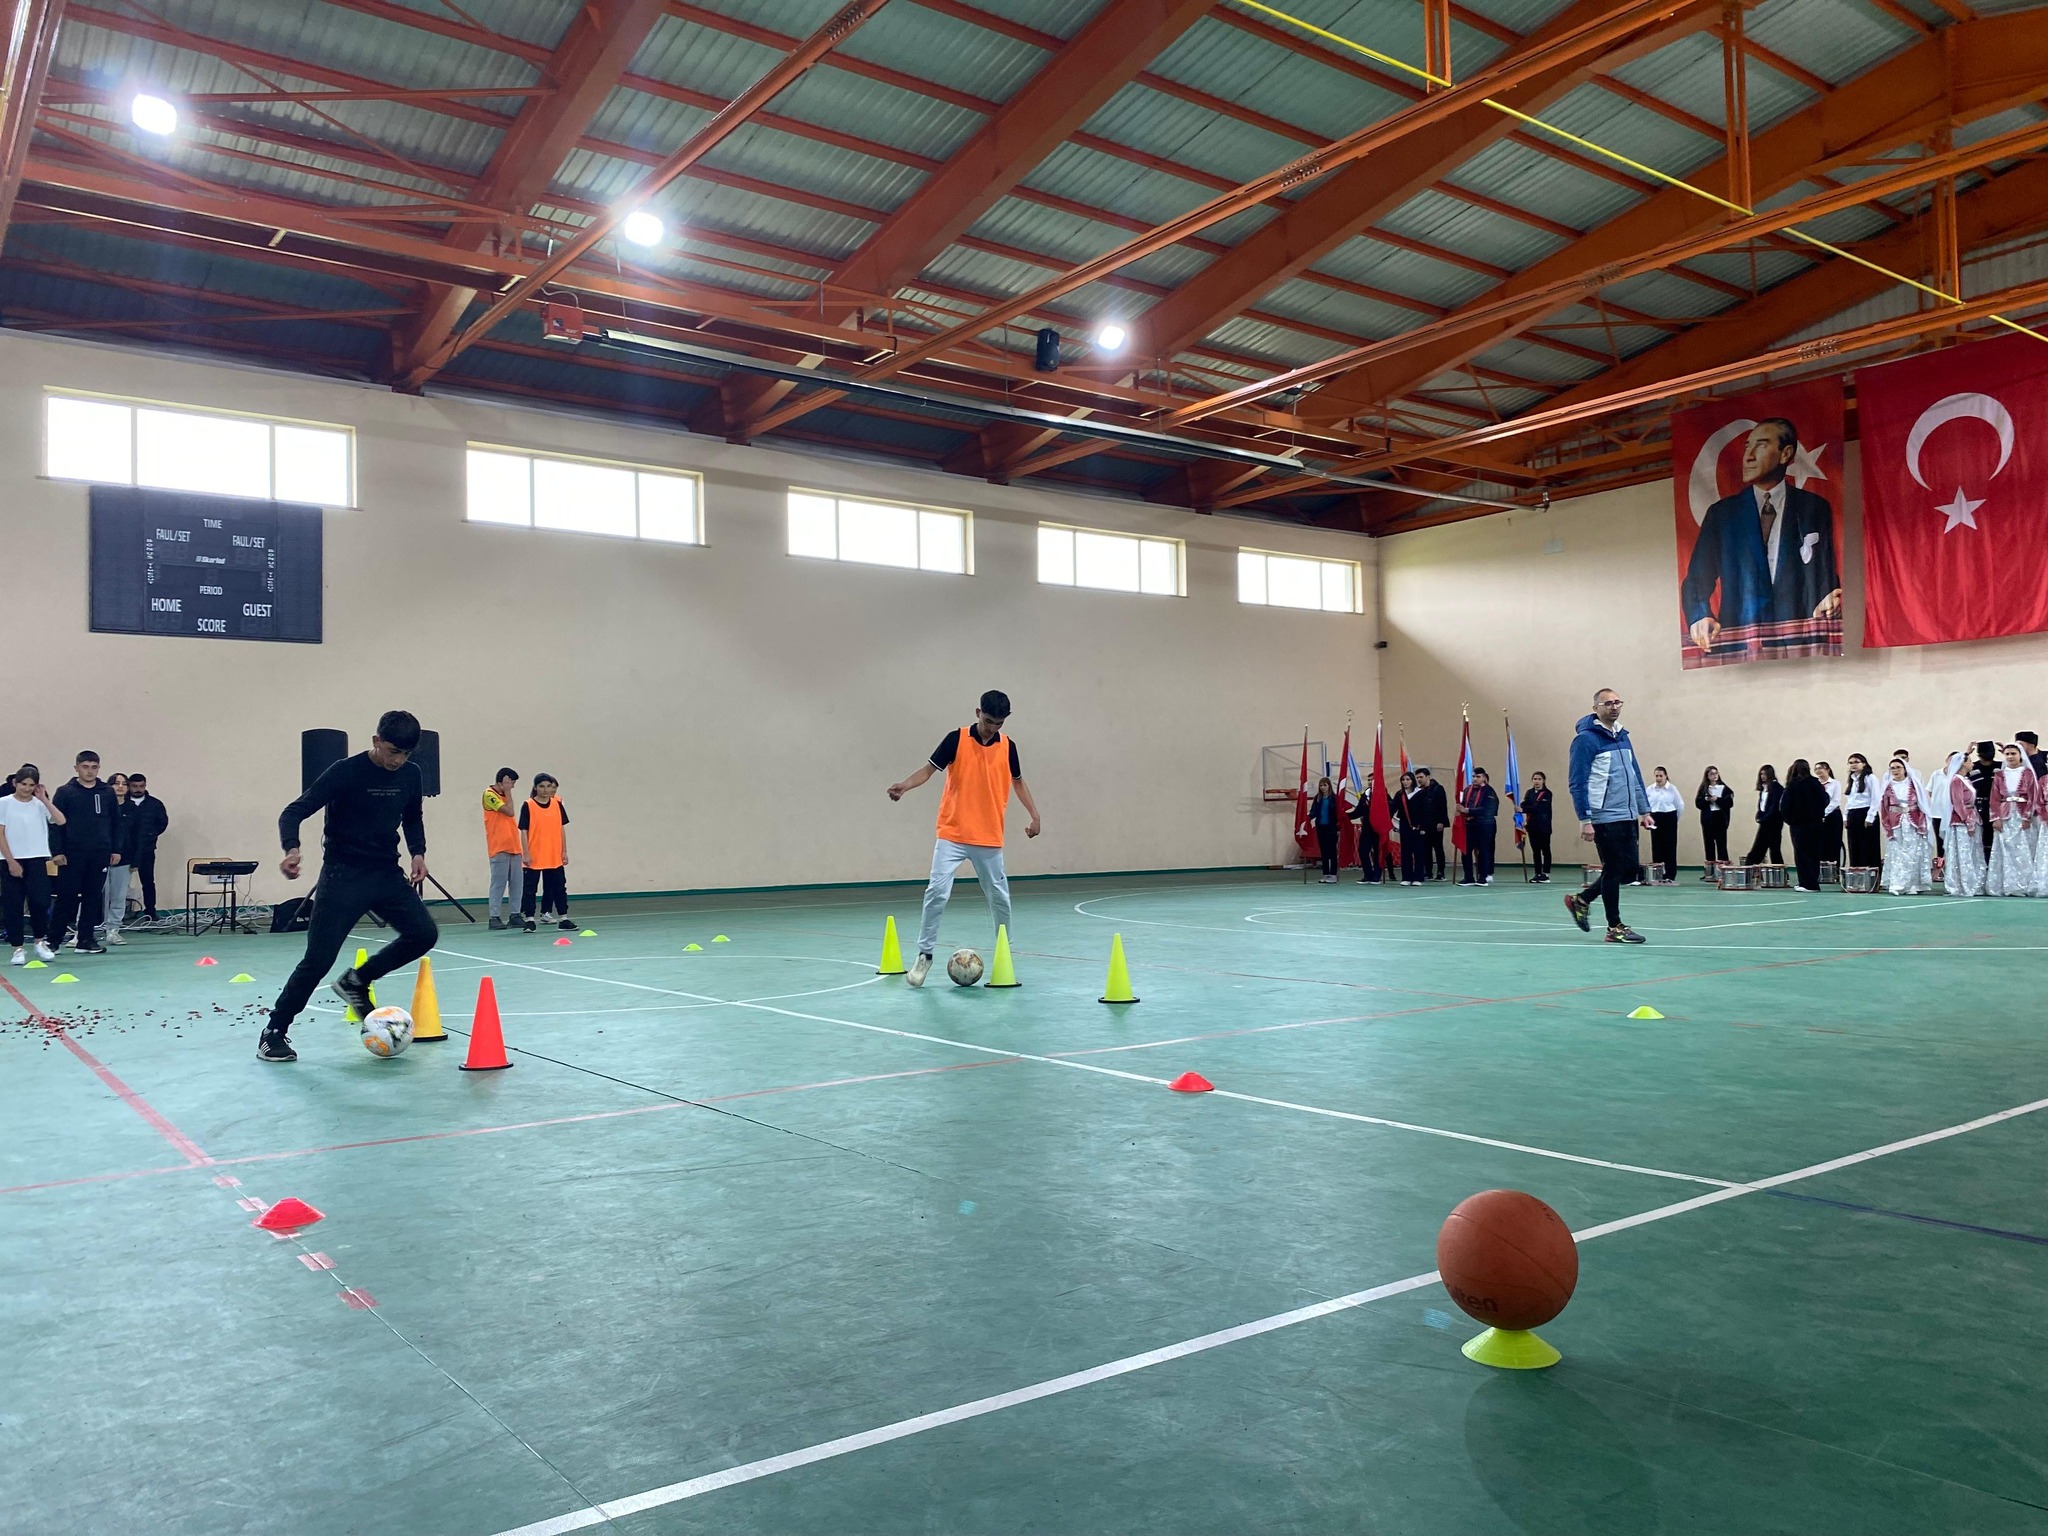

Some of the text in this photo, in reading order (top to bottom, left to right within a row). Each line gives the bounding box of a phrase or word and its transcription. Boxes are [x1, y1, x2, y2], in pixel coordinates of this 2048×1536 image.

[203, 518, 222, 529] TIME
[156, 528, 191, 543] FAUL/SET
[232, 535, 265, 549] FAUL/SET
[199, 585, 223, 595] PERIOD
[151, 597, 182, 612] HOME
[242, 603, 273, 617] GUEST
[197, 618, 226, 633] SCORE
